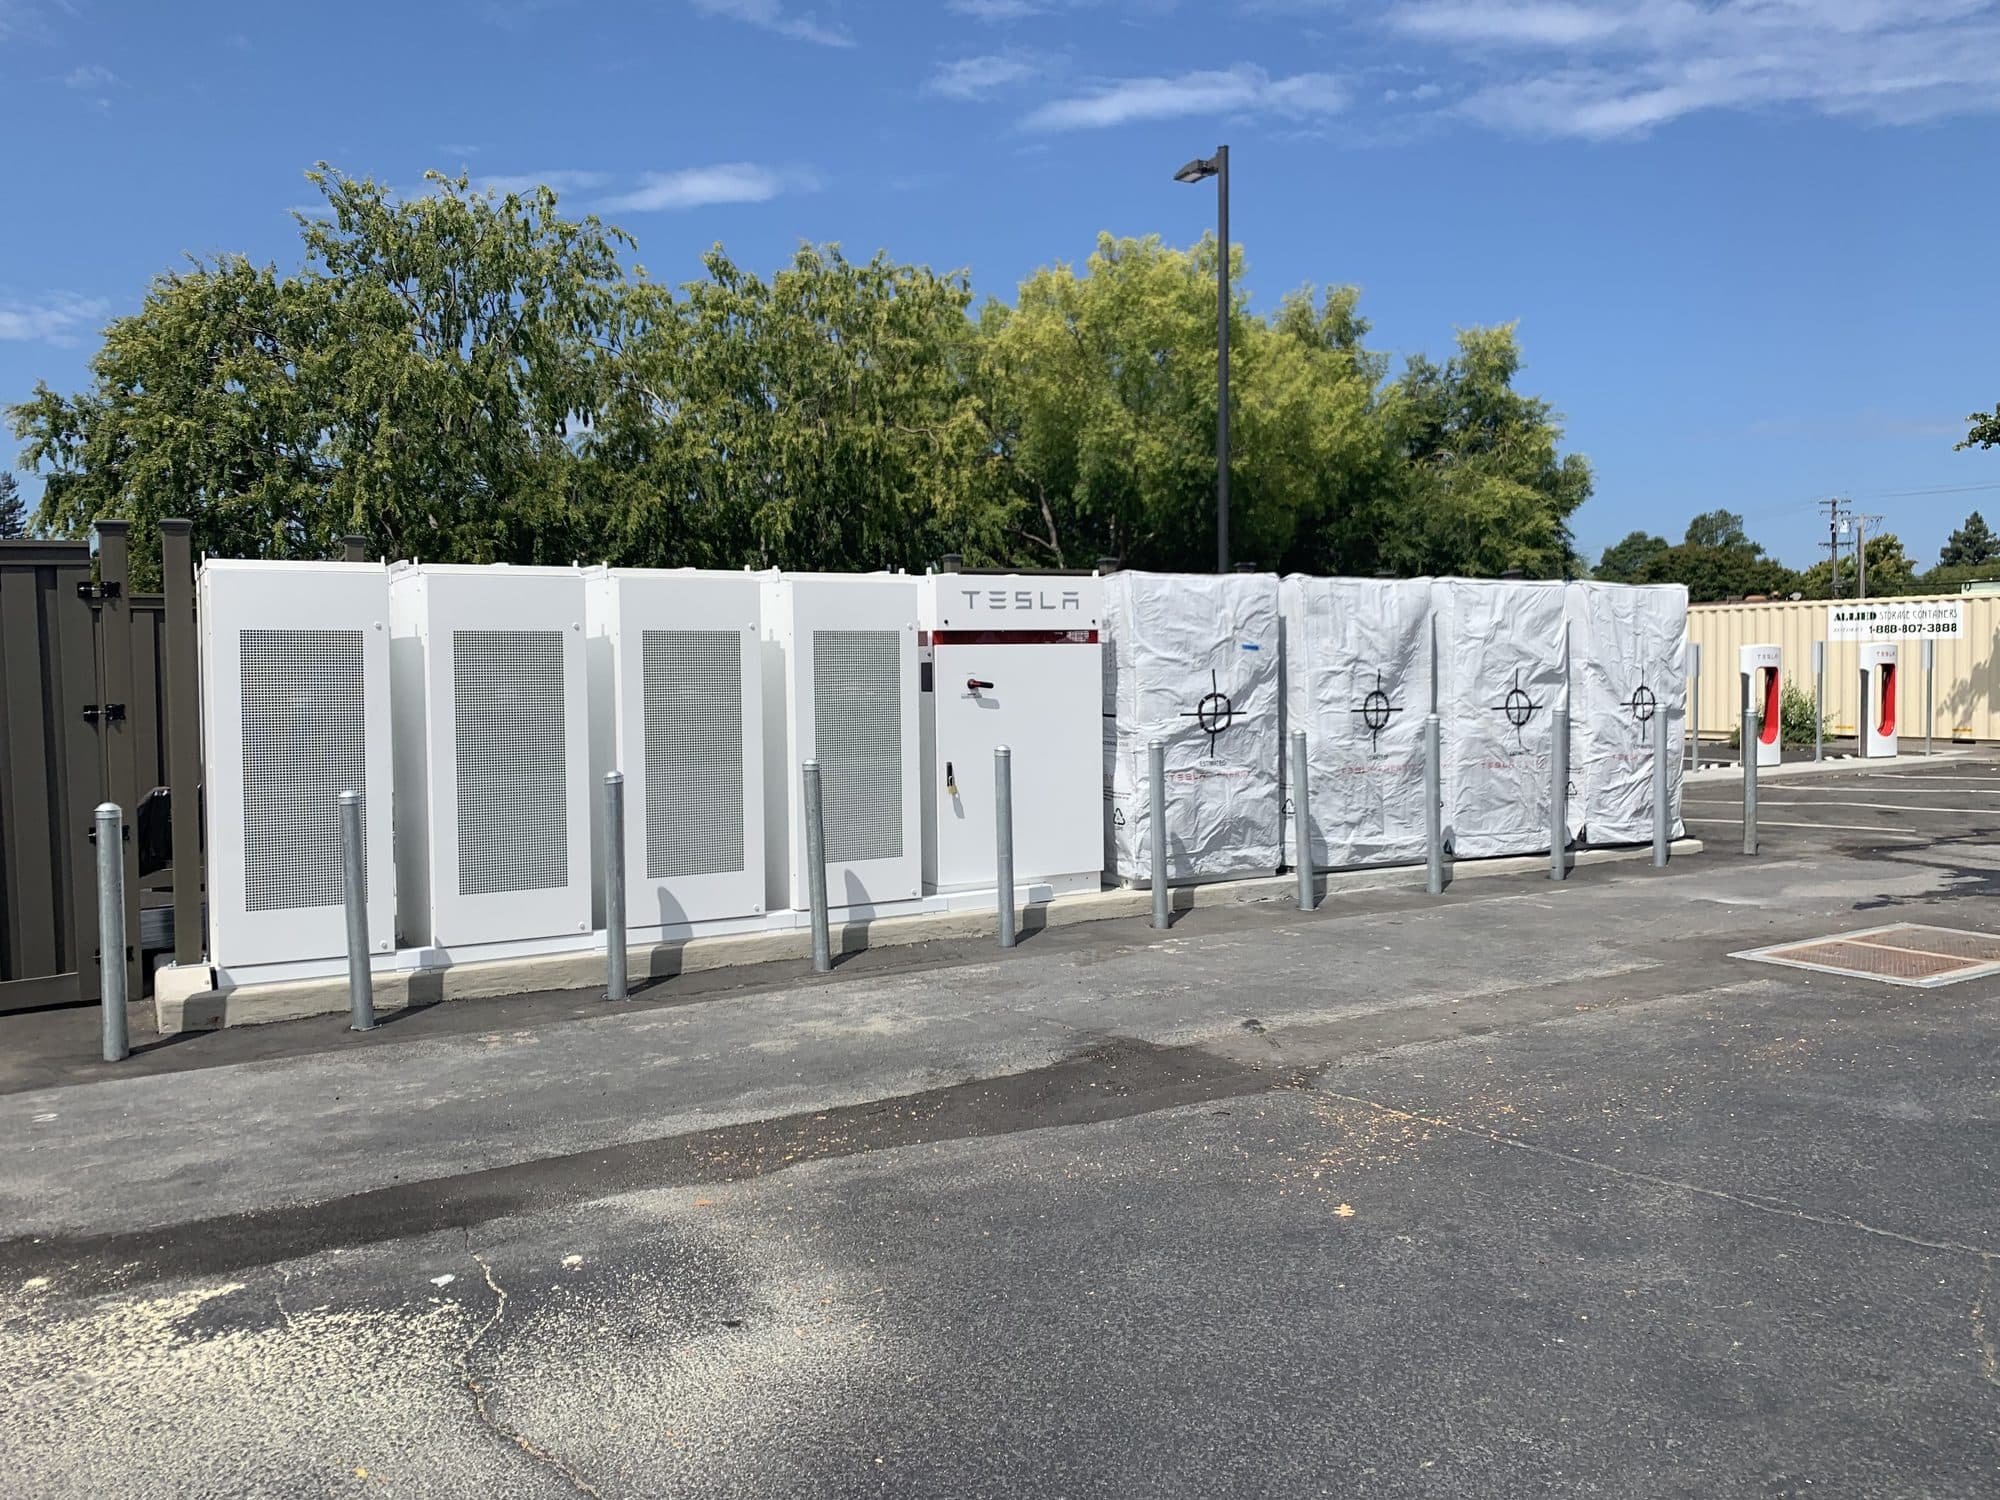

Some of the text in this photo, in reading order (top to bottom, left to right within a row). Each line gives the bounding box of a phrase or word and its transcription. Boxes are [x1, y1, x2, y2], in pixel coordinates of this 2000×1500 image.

[961, 590, 1079, 610] TESLA
[1834, 608, 1958, 622] ALLIED STORAGE CONTAINERS
[1869, 622, 1958, 634] 1-888-807-3888
